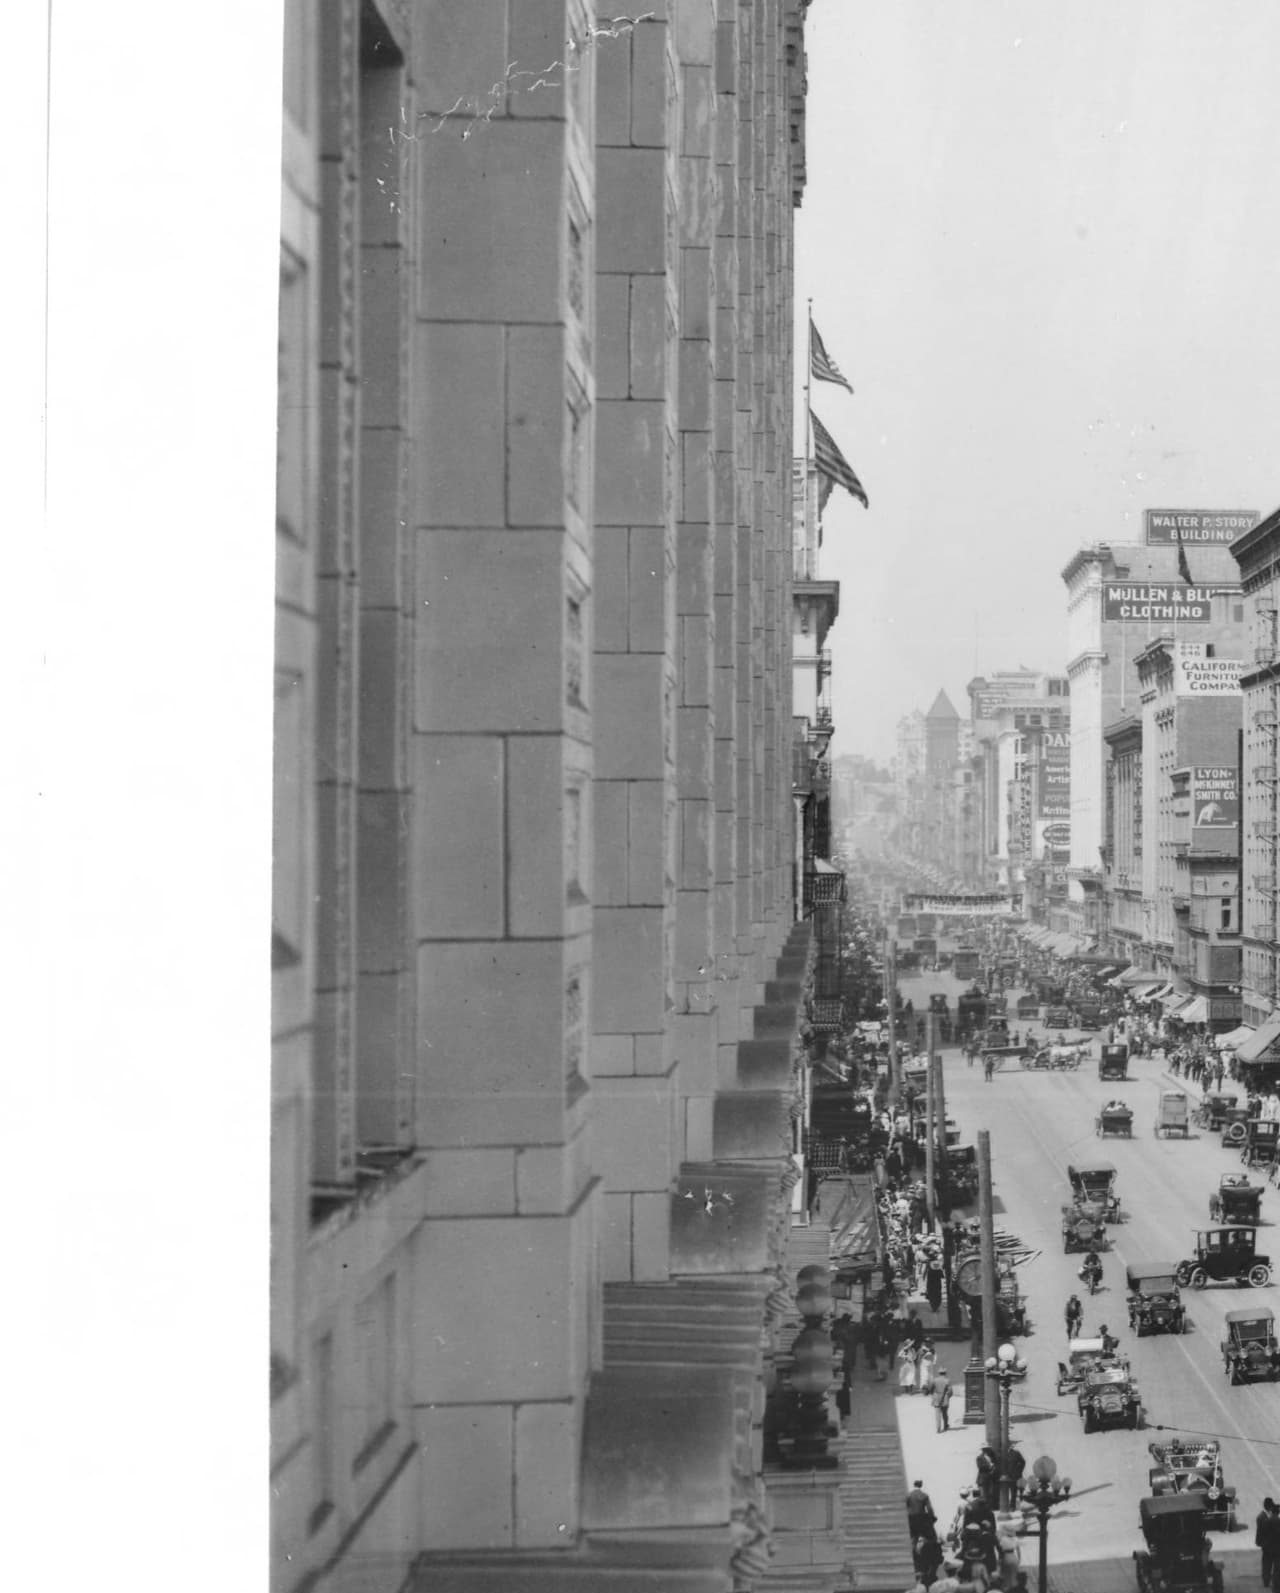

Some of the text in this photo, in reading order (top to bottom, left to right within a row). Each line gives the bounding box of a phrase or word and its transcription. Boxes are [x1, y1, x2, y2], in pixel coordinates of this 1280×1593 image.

[1152, 516, 1254, 527] WALTER P. STORY
[1170, 530, 1234, 541] BUILDING
[1109, 588, 1168, 602] MULLEN
[1172, 589, 1182, 602] &
[1120, 606, 1203, 618] CLOTHING
[1196, 790, 1238, 801] SMITH CO.
